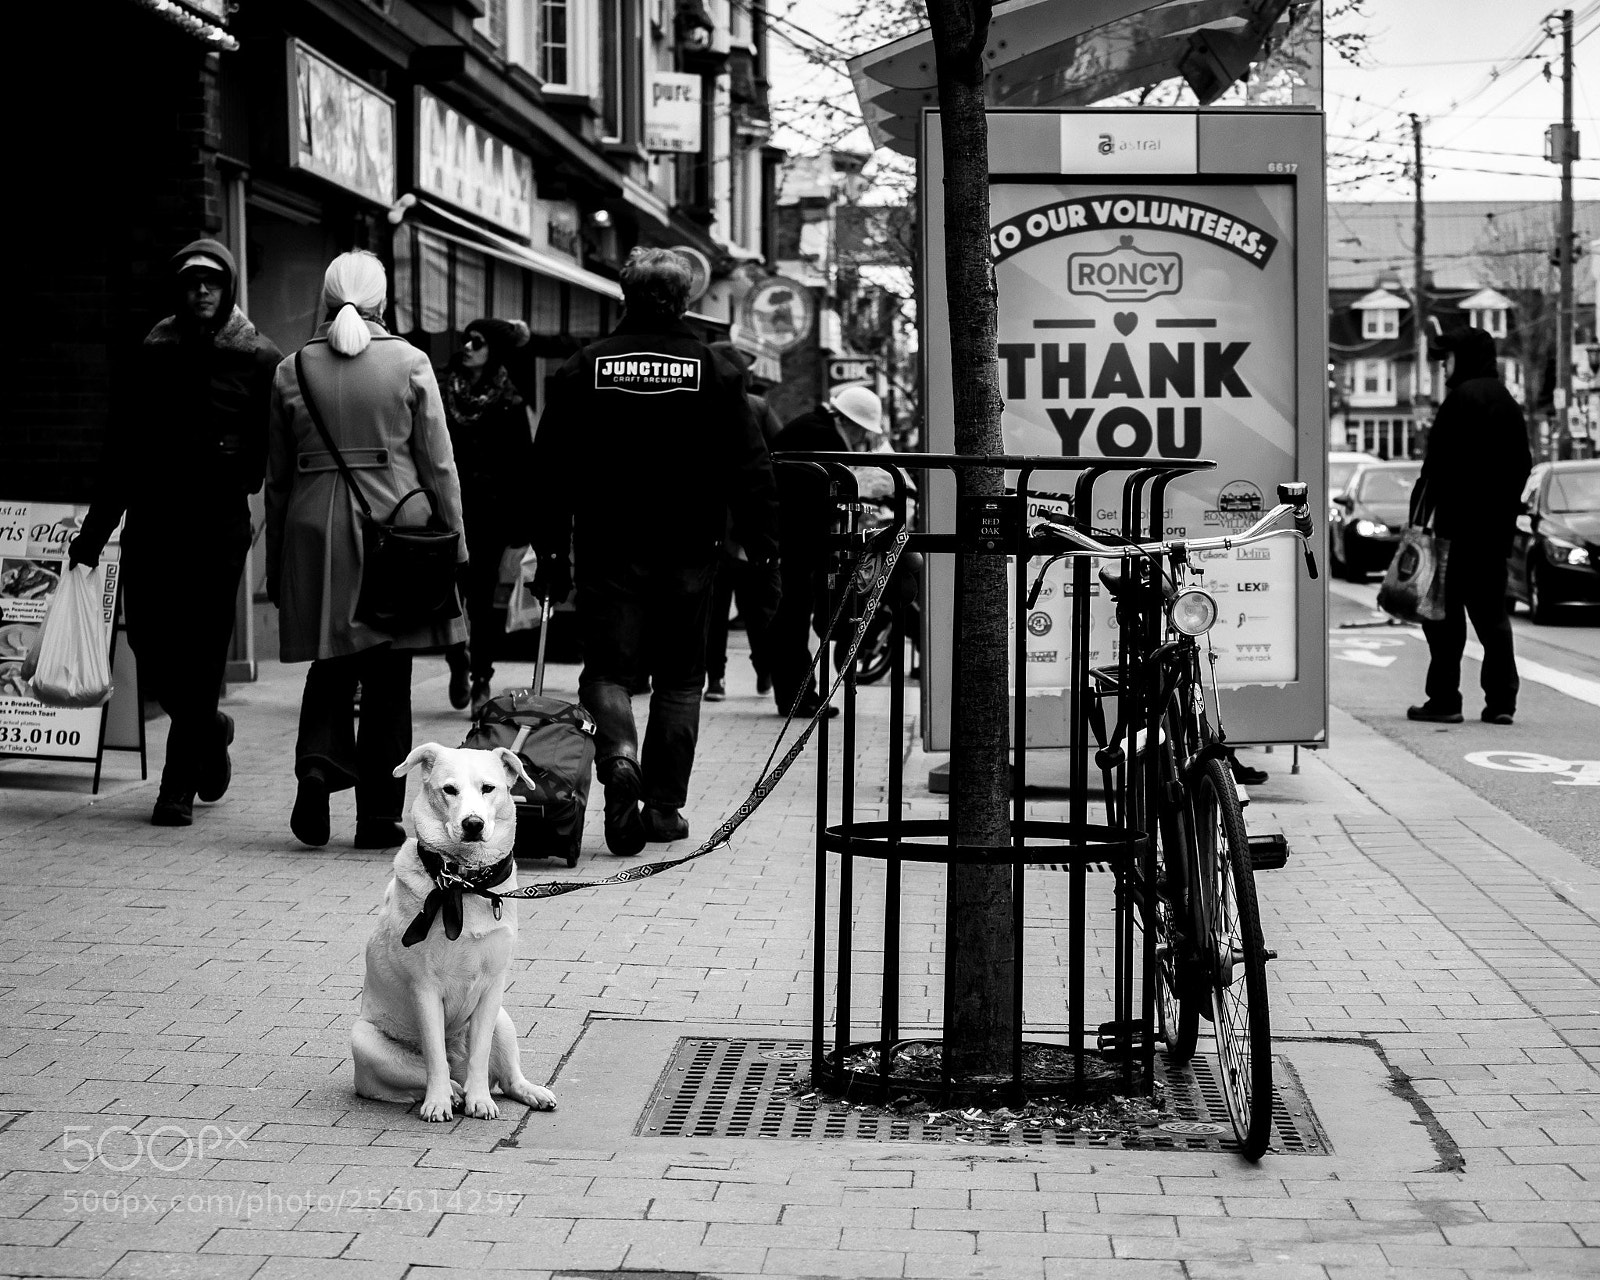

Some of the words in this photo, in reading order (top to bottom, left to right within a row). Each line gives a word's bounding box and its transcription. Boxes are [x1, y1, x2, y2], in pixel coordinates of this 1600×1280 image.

[1119, 139, 1161, 151] astral
[1268, 162, 1298, 173] 6617
[1026, 204, 1088, 238] OUR
[1091, 199, 1267, 261] VOLUNTEERS:
[1078, 262, 1176, 286] RONCY
[602, 361, 694, 377] JUNCTION
[1000, 341, 1253, 400] THANK
[644, 376, 683, 384] BREWING
[1046, 406, 1203, 460] YOU
[0, 506, 11, 515] st
[15, 507, 27, 516] at
[1096, 509, 1119, 520] Get
[31, 521, 81, 543] Plac
[1237, 583, 1261, 592] LEX
[25, 745, 38, 753] Out
